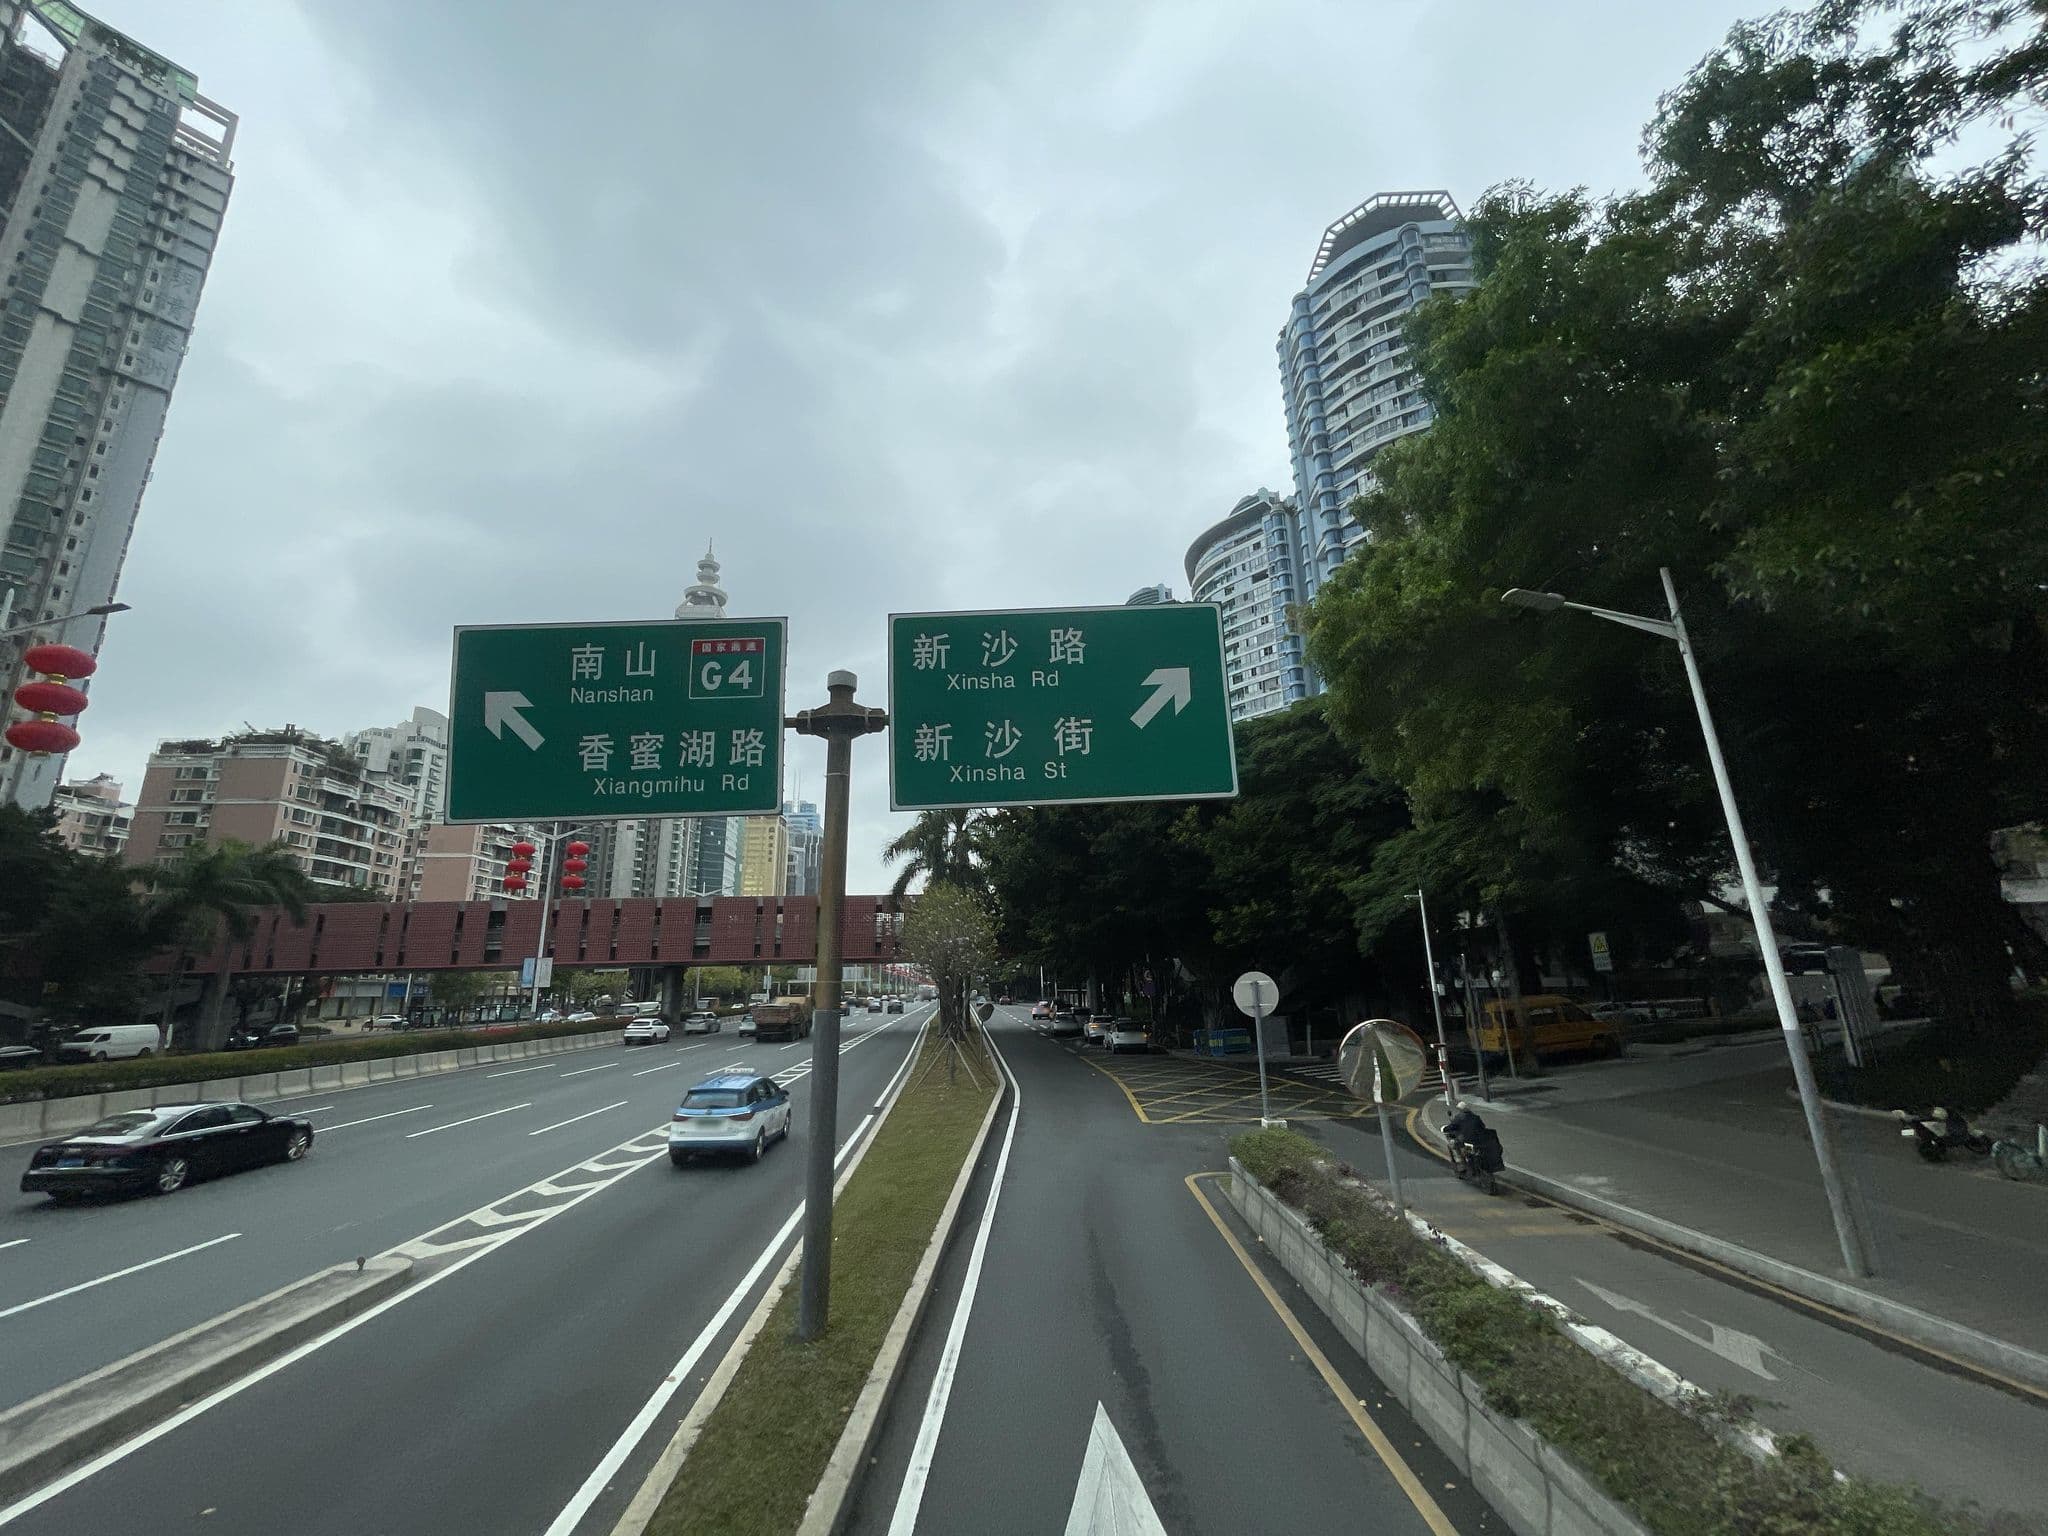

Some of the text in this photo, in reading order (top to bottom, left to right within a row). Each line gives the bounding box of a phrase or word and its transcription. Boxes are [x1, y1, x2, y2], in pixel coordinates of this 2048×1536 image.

[571, 642, 656, 681] 南山
[912, 627, 1088, 671] 新沙路
[701, 660, 753, 690] G4
[947, 670, 1059, 690] Xinsha Rd
[570, 686, 654, 704] Nanshan
[578, 729, 767, 772] 香蜜湖路
[914, 717, 1093, 762] 新沙街
[593, 773, 749, 798] Xiangmihu Rd
[950, 762, 1067, 783] Xinsha St
